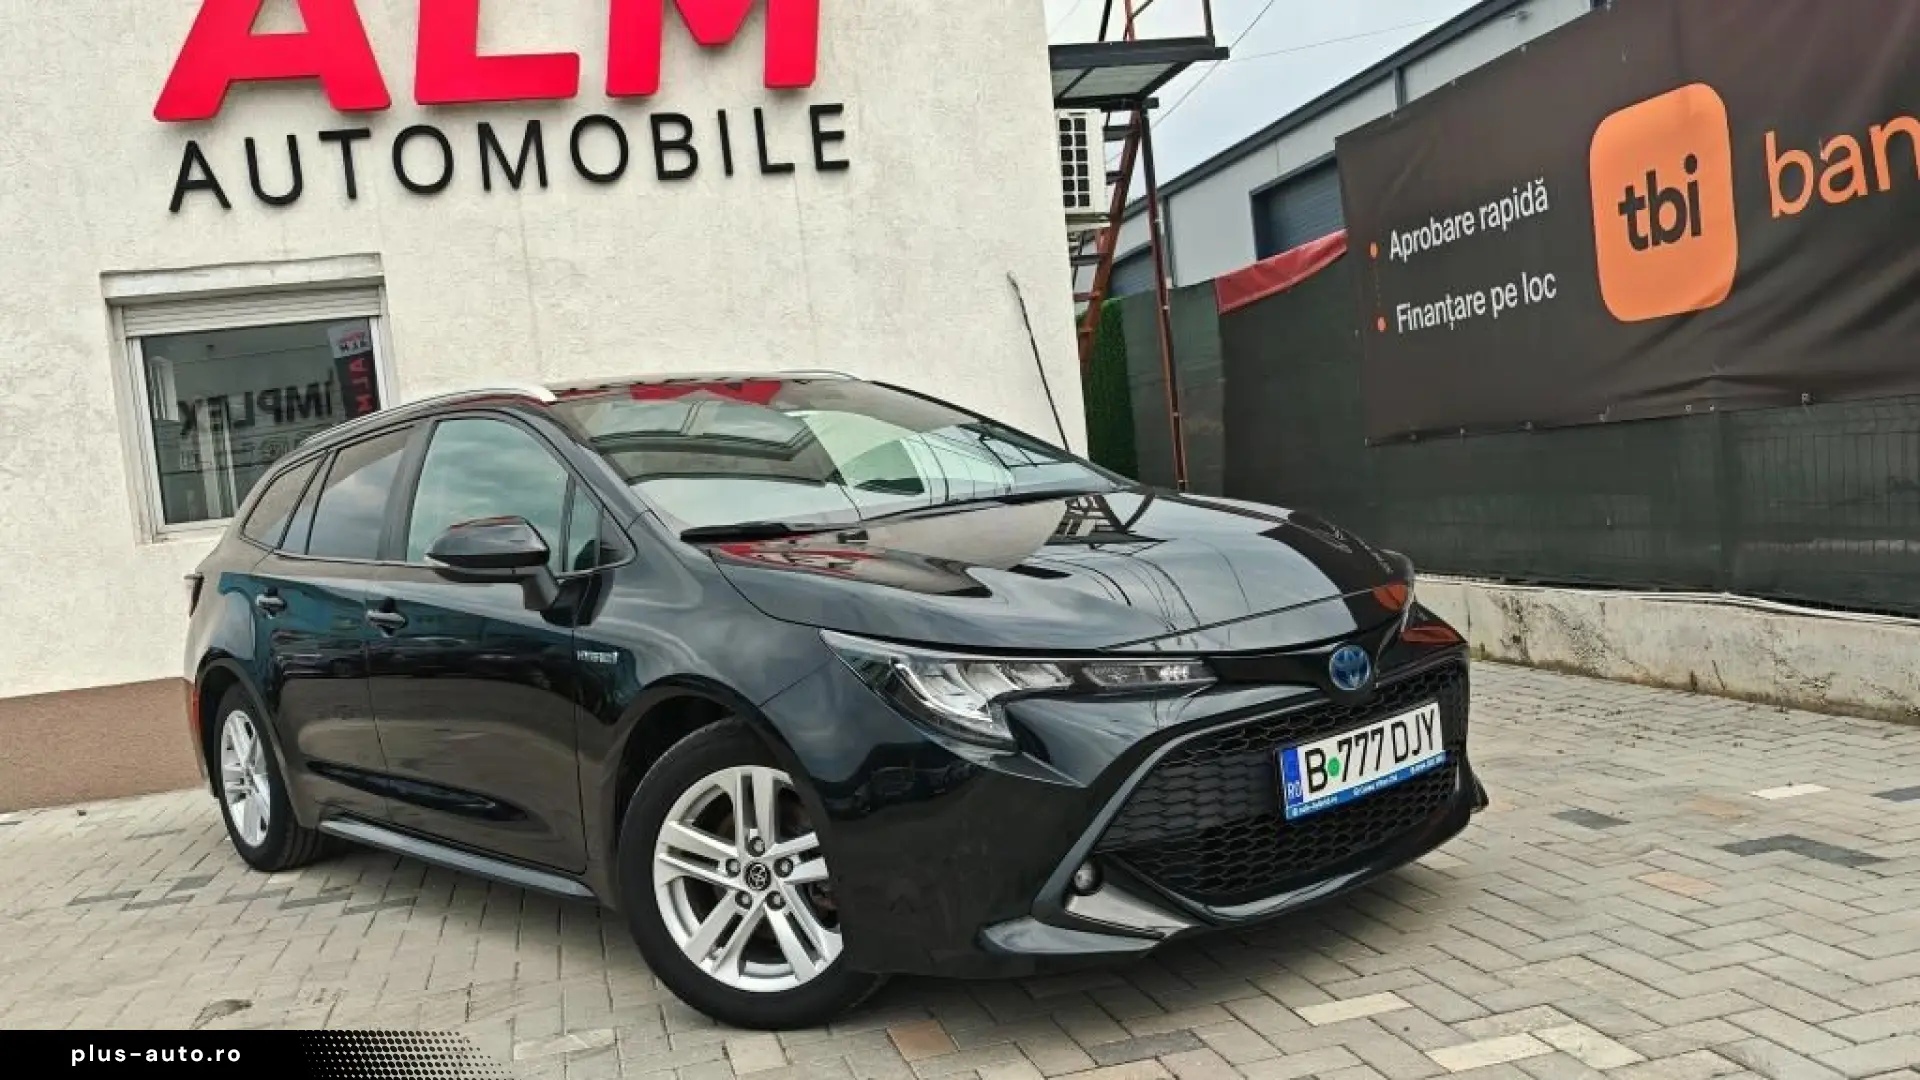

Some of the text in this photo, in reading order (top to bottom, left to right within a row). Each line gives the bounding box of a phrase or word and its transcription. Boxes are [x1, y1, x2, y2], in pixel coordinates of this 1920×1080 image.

[169, 103, 850, 213] AUTOMOBILE
[1388, 178, 1549, 262] Aprobare rapidă
[1618, 153, 1702, 251] tbi
[1396, 269, 1558, 335] Finanțare pe loc
[1304, 747, 1328, 793] B
[1337, 725, 1384, 783] 777
[1391, 708, 1435, 764] DJY
